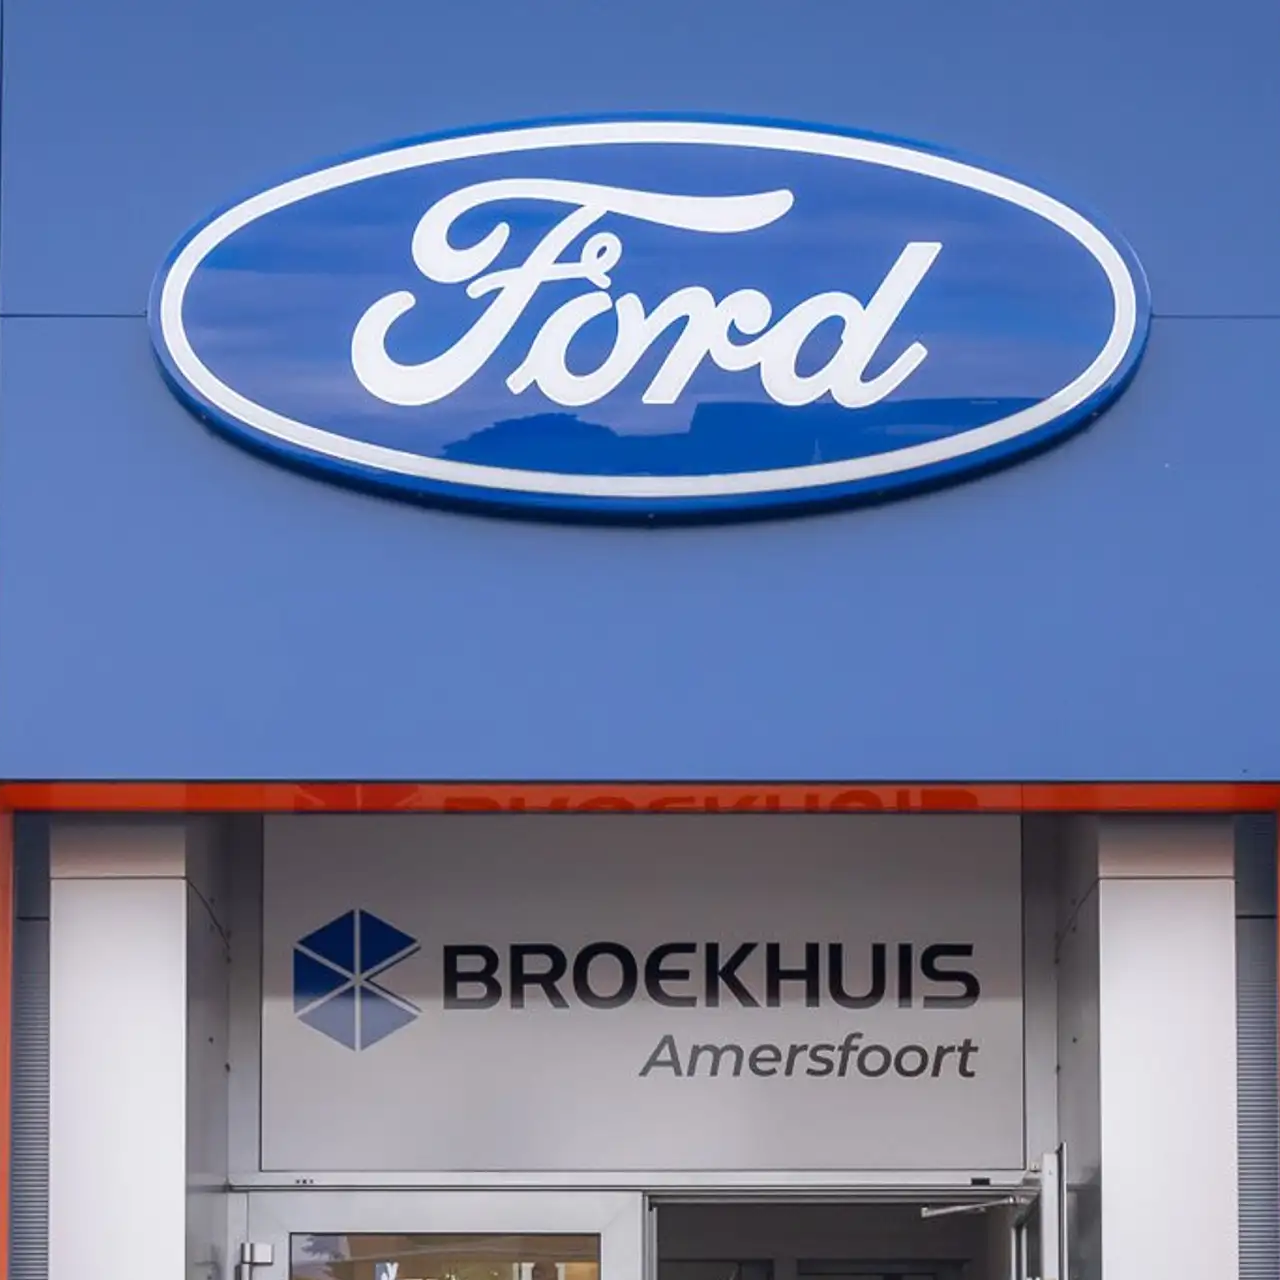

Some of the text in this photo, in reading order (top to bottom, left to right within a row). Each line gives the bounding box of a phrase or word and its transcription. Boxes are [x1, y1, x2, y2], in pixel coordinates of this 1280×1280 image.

[350, 178, 941, 407] Ford
[443, 941, 981, 1009] BROEKHUIS
[639, 1032, 979, 1078] Amersfoort
